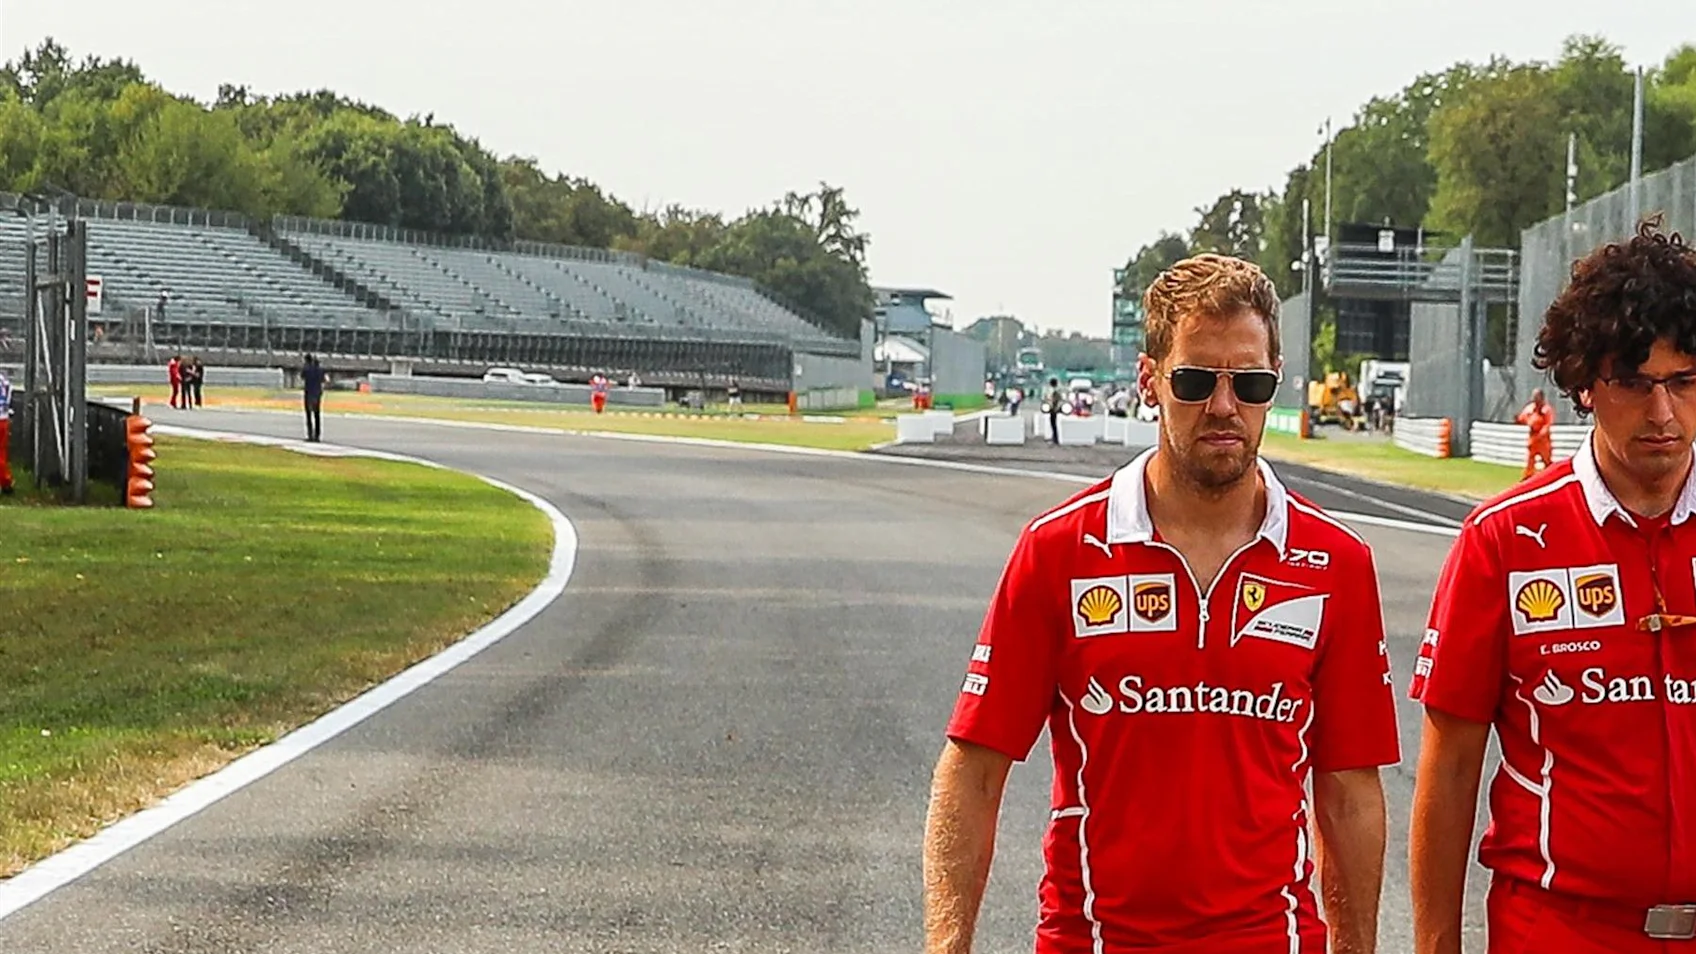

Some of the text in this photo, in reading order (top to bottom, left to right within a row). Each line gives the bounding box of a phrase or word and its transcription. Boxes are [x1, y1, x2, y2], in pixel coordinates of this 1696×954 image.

[1288, 548, 1330, 567] 70
[1136, 594, 1169, 618] ups
[1579, 586, 1614, 612] ups
[1552, 640, 1601, 654] BROSCO
[1118, 675, 1303, 722] Santander
